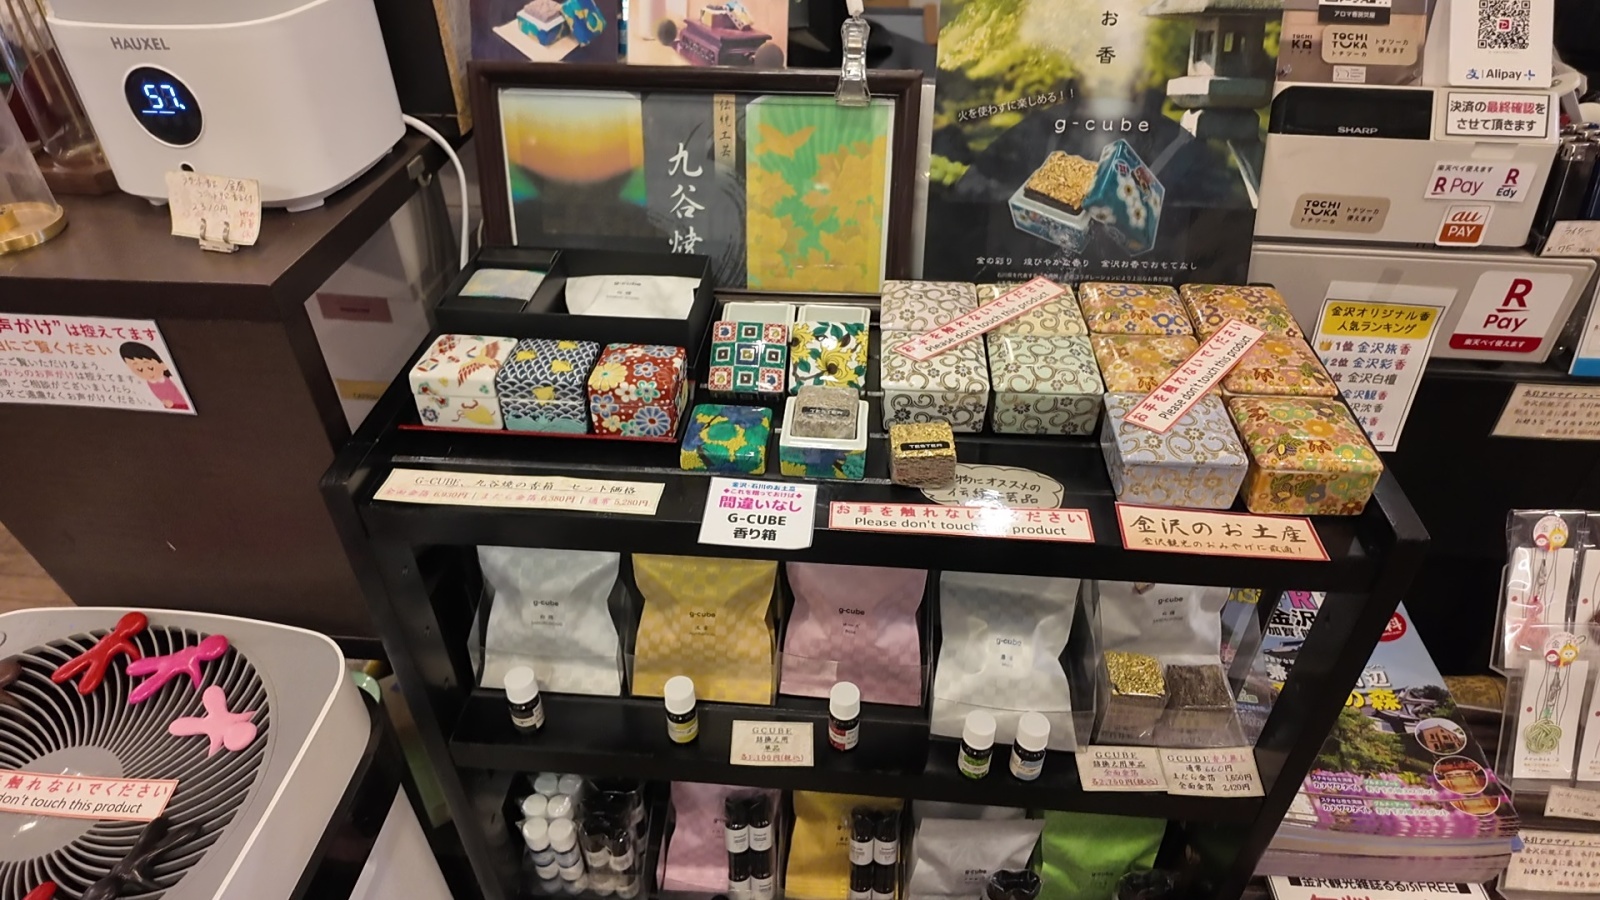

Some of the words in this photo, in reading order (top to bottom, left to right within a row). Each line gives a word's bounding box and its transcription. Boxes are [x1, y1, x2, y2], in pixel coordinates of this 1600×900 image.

[1332, 32, 1368, 41] TOCHI
[111, 36, 170, 51] HAUXEL
[1486, 69, 1522, 80] Alipay
[1450, 100, 1546, 115] 決済の最終確認を
[1054, 117, 1150, 134] g-cube
[1337, 126, 1378, 134] SHARP
[1457, 118, 1537, 131] させて頂きます
[1450, 177, 1484, 196] Pay
[1496, 188, 1517, 198] Edy
[1305, 200, 1341, 209] TOCHI
[1451, 211, 1482, 222] au
[1448, 226, 1477, 237] PAY
[1331, 306, 1431, 321] 金沢オリジナル香
[925, 337, 957, 352] Please
[979, 314, 1003, 329] touch
[1000, 305, 1021, 319] this
[1018, 291, 1050, 311] product
[1337, 320, 1418, 334] 人気ランキング
[1482, 314, 1528, 333] Pay
[1335, 341, 1354, 352] 1位
[1330, 358, 1348, 367] 2位
[1158, 399, 1187, 420] Please
[1198, 365, 1220, 386] touch
[1214, 355, 1230, 370] this
[1226, 335, 1253, 359] product
[719, 495, 802, 512] 間違いなし
[727, 513, 787, 526] G-CUBE
[855, 517, 897, 529] Please
[901, 518, 936, 529] don't
[941, 520, 978, 531] touch
[1012, 525, 1067, 537] product
[1130, 515, 1307, 543] 金沢のお土産
[733, 527, 777, 541] 香り箱
[838, 607, 865, 616] g-cube
[752, 727, 792, 735] GCUBE
[1095, 751, 1138, 760] GCUBE
[30, 796, 66, 810] touch
[69, 798, 92, 812] this
[93, 800, 143, 814] product
